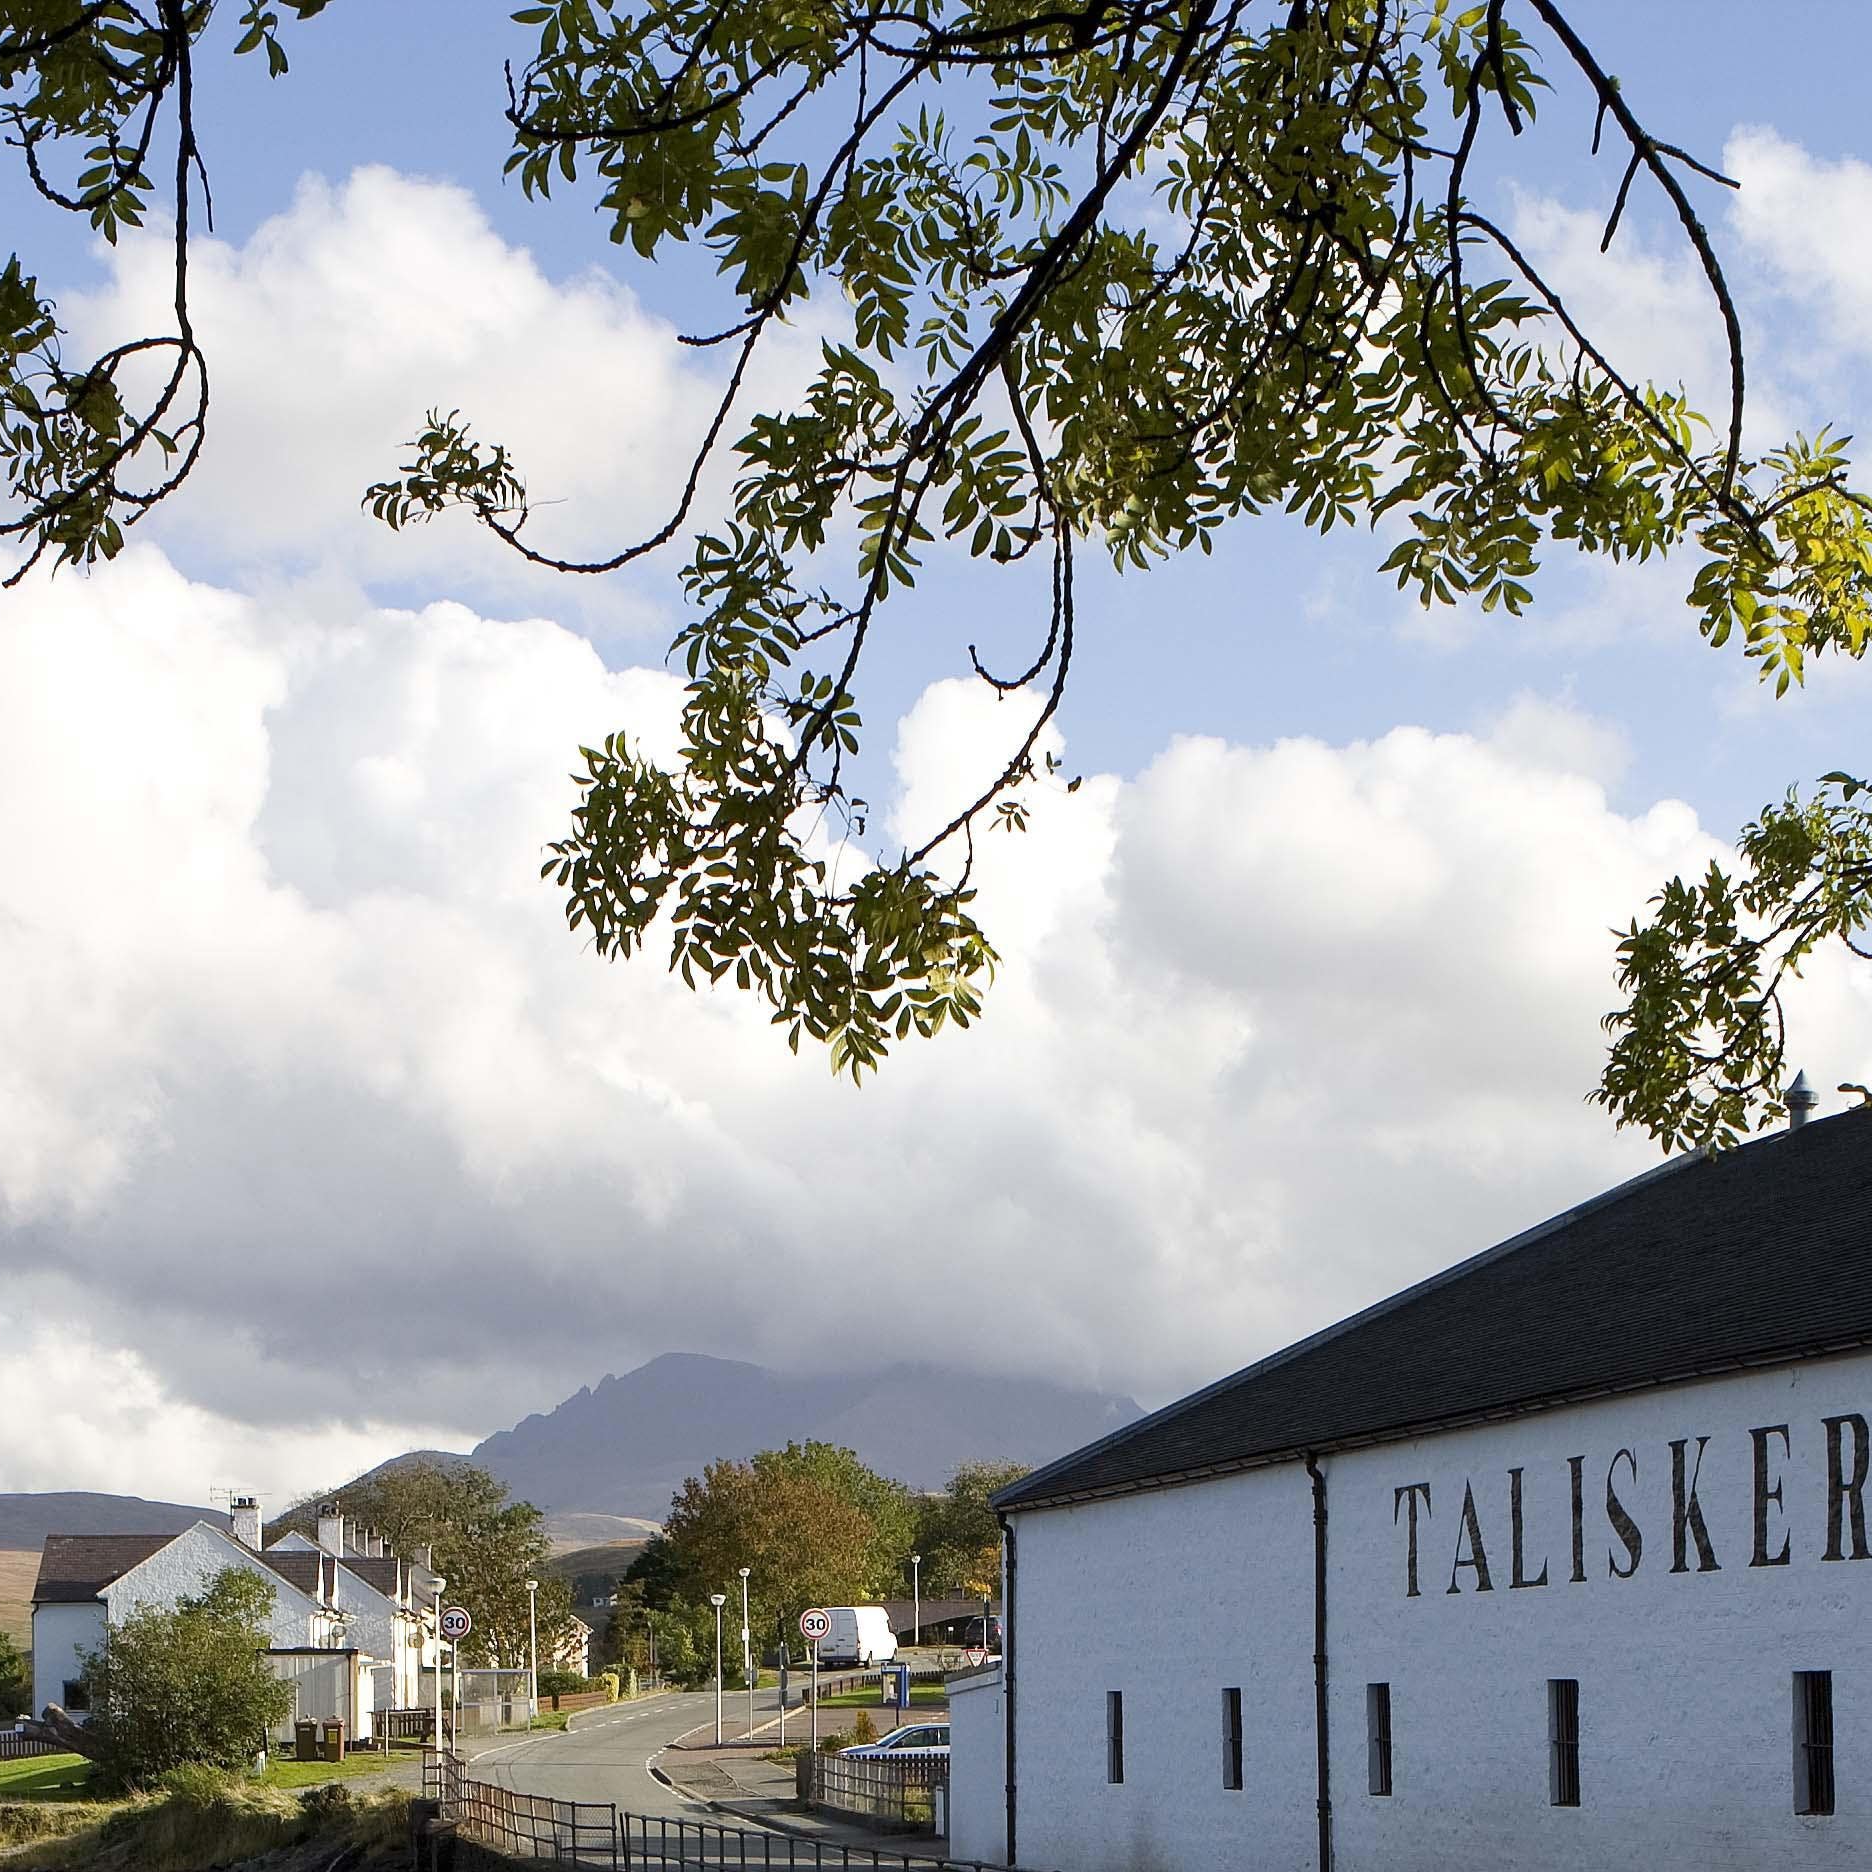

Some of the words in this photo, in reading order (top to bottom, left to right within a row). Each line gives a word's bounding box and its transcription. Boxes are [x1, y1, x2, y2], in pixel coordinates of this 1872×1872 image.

[1394, 1412, 1872, 1598] TALISKER
[444, 1616, 465, 1630] 30
[805, 1618, 826, 1631] 30
